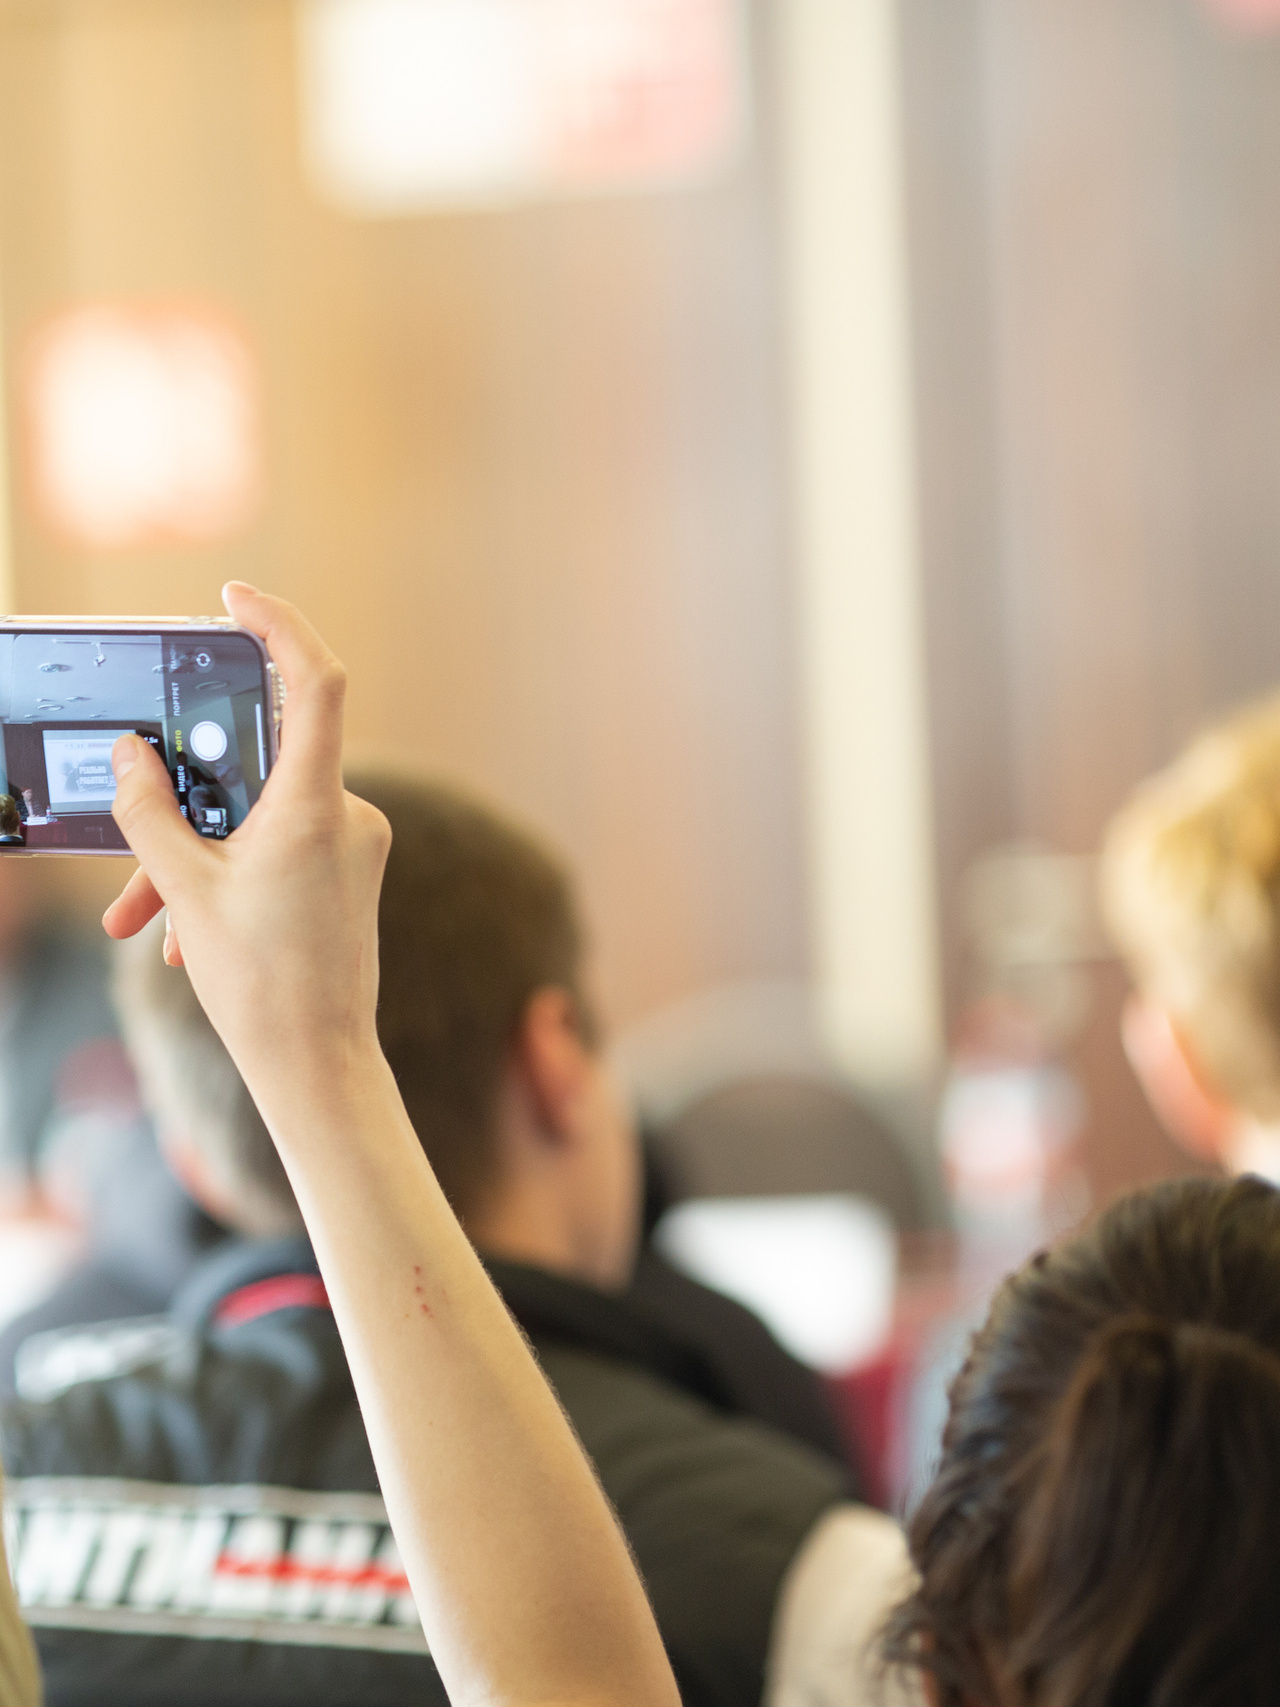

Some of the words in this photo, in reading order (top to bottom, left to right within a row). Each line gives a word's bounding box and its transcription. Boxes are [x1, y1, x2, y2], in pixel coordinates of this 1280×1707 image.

[171, 682, 181, 716] ПОРТРЕТ
[175, 729, 183, 752] ФОТО
[177, 765, 186, 792] ВИДЕО
